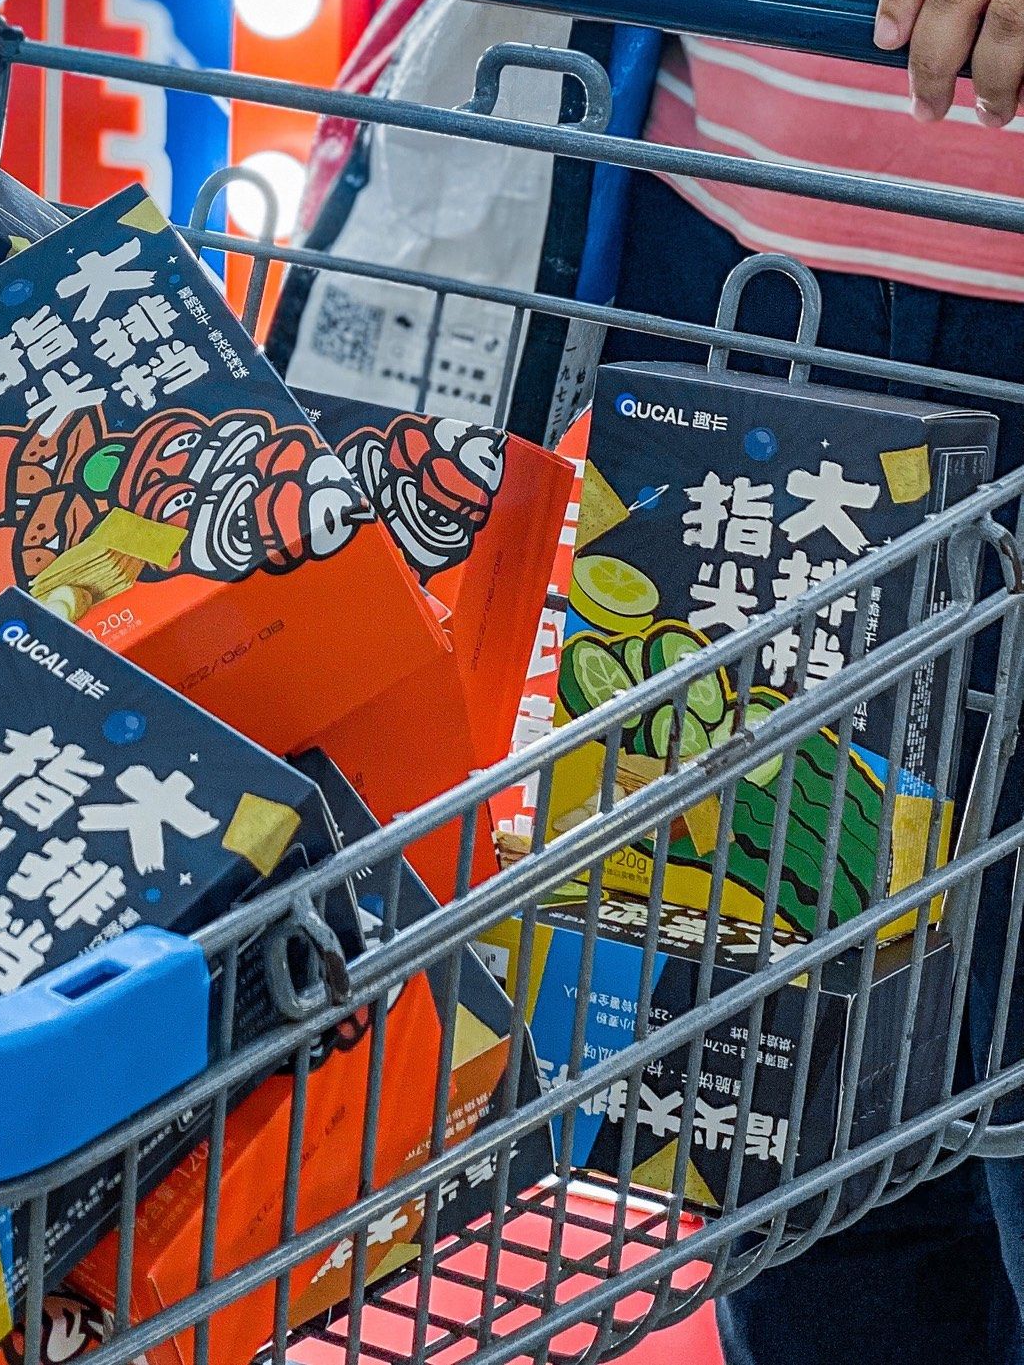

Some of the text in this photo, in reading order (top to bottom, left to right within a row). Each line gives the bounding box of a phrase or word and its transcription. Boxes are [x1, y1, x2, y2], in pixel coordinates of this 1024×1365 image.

[620, 398, 729, 432] QUCAL 趣卡
[2, 625, 70, 679] QUCAL
[66, 668, 111, 701] 趣卡
